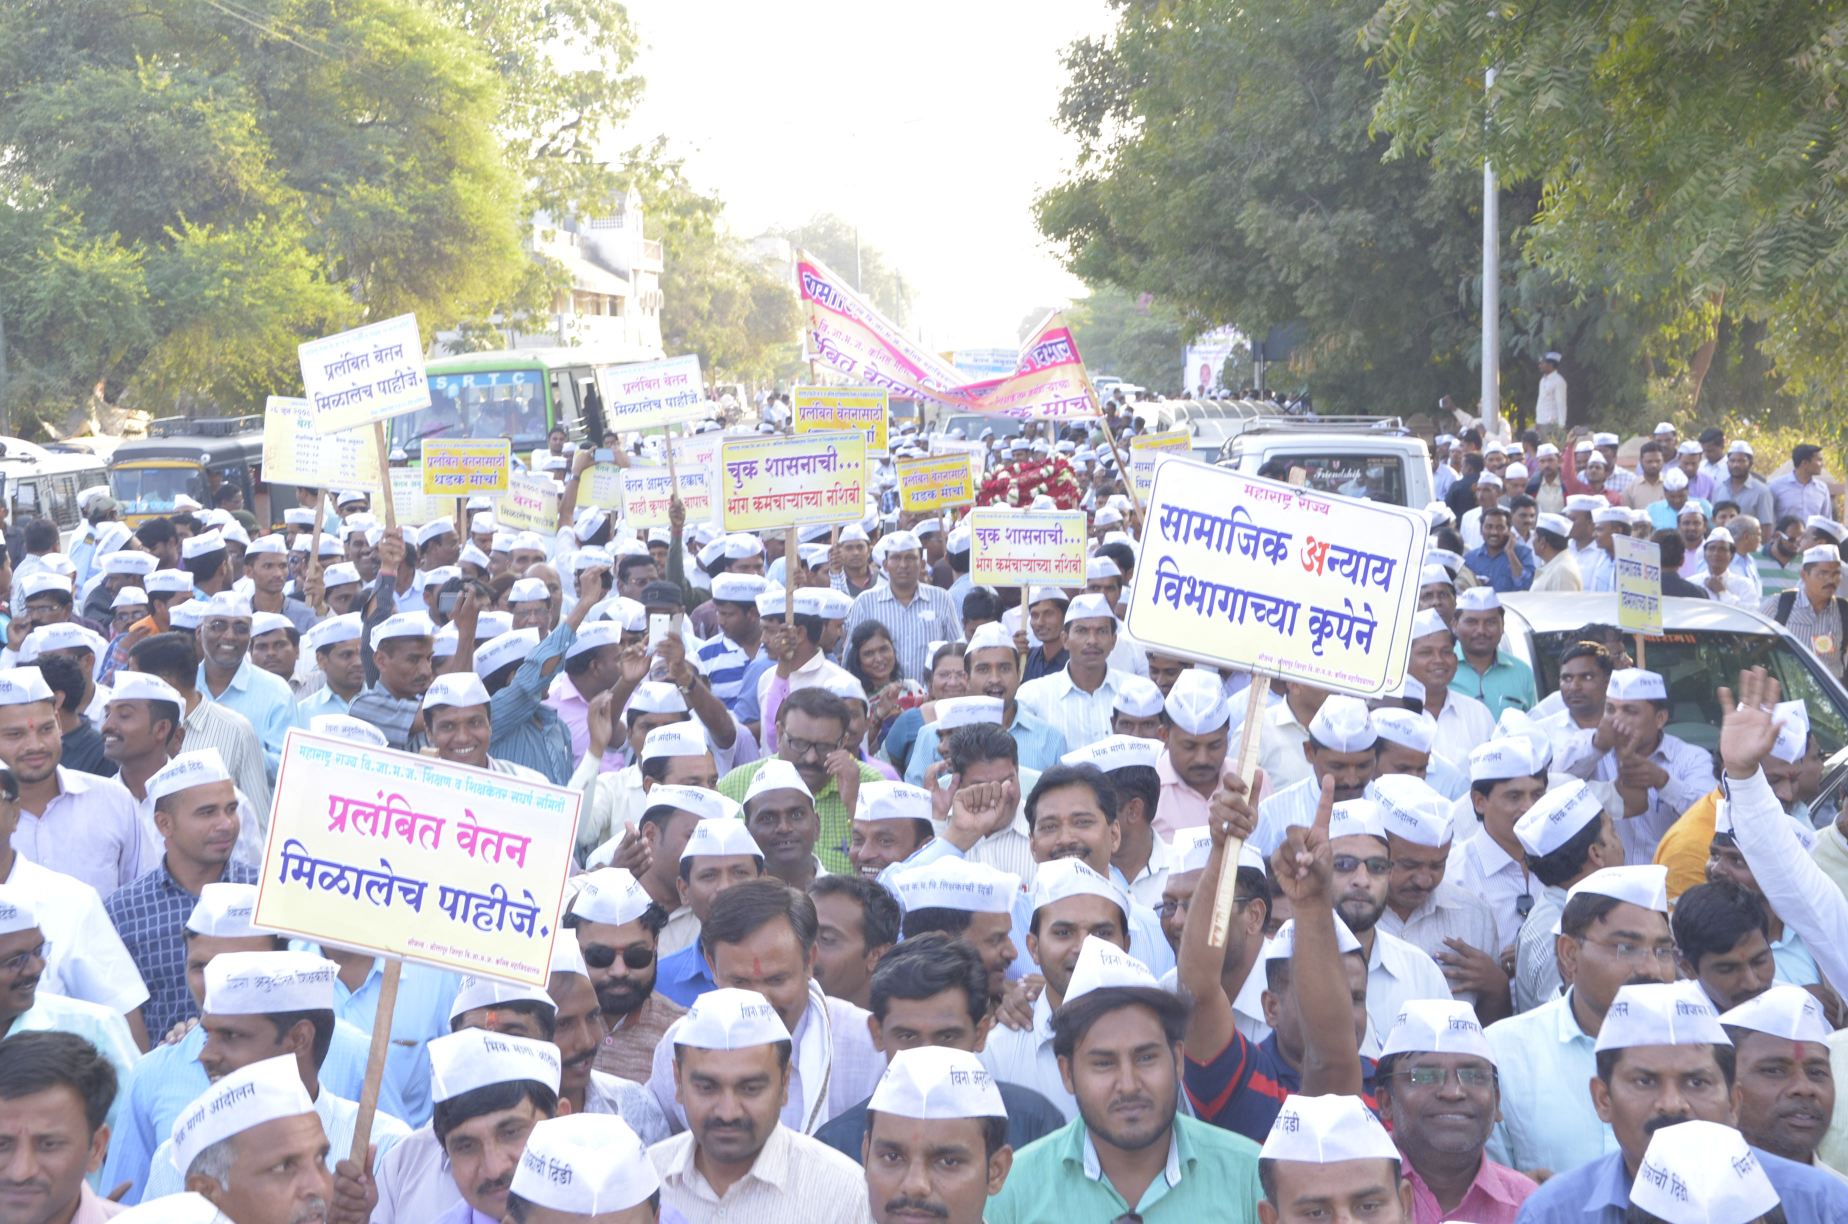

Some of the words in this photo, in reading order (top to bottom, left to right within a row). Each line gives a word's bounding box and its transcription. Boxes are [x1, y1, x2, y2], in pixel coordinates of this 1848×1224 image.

[324, 351, 371, 381] प्रलंबित
[374, 343, 404, 365] वेतन
[436, 376, 448, 390] S
[463, 374, 476, 388] R
[488, 373, 500, 387] T
[512, 372, 525, 385] C
[623, 377, 661, 395] प्रलंबित
[663, 373, 688, 390] वेतन
[314, 381, 374, 413] मिळालेच
[614, 397, 662, 417] मिळालेच
[799, 401, 833, 422] प्रलंबित
[837, 402, 884, 422] वेतनासाठी
[435, 472, 465, 486] धडक
[469, 470, 498, 486] मोर्चा
[624, 475, 643, 492] वेतन
[727, 460, 759, 489] चुक
[1314, 467, 1362, 480] Friendship
[628, 495, 647, 515] नाही
[827, 480, 861, 506] नशिबी
[1244, 484, 1293, 511] महाराष्ट्र
[1299, 493, 1331, 516] राज्य
[975, 527, 1000, 550] चुक
[1160, 504, 1293, 566] सामाजिक
[1300, 535, 1398, 593] अन्याय
[1054, 552, 1082, 574] नशिबी
[1152, 555, 1302, 637] विभागाच्या
[1308, 598, 1378, 656] कृपेने
[328, 789, 446, 850] प्रलंबित
[456, 808, 532, 869] वेतन
[279, 838, 428, 913] मिळालेच
[438, 883, 550, 938] पाहीजे.
[208, 1082, 256, 1115] आंदोलन
